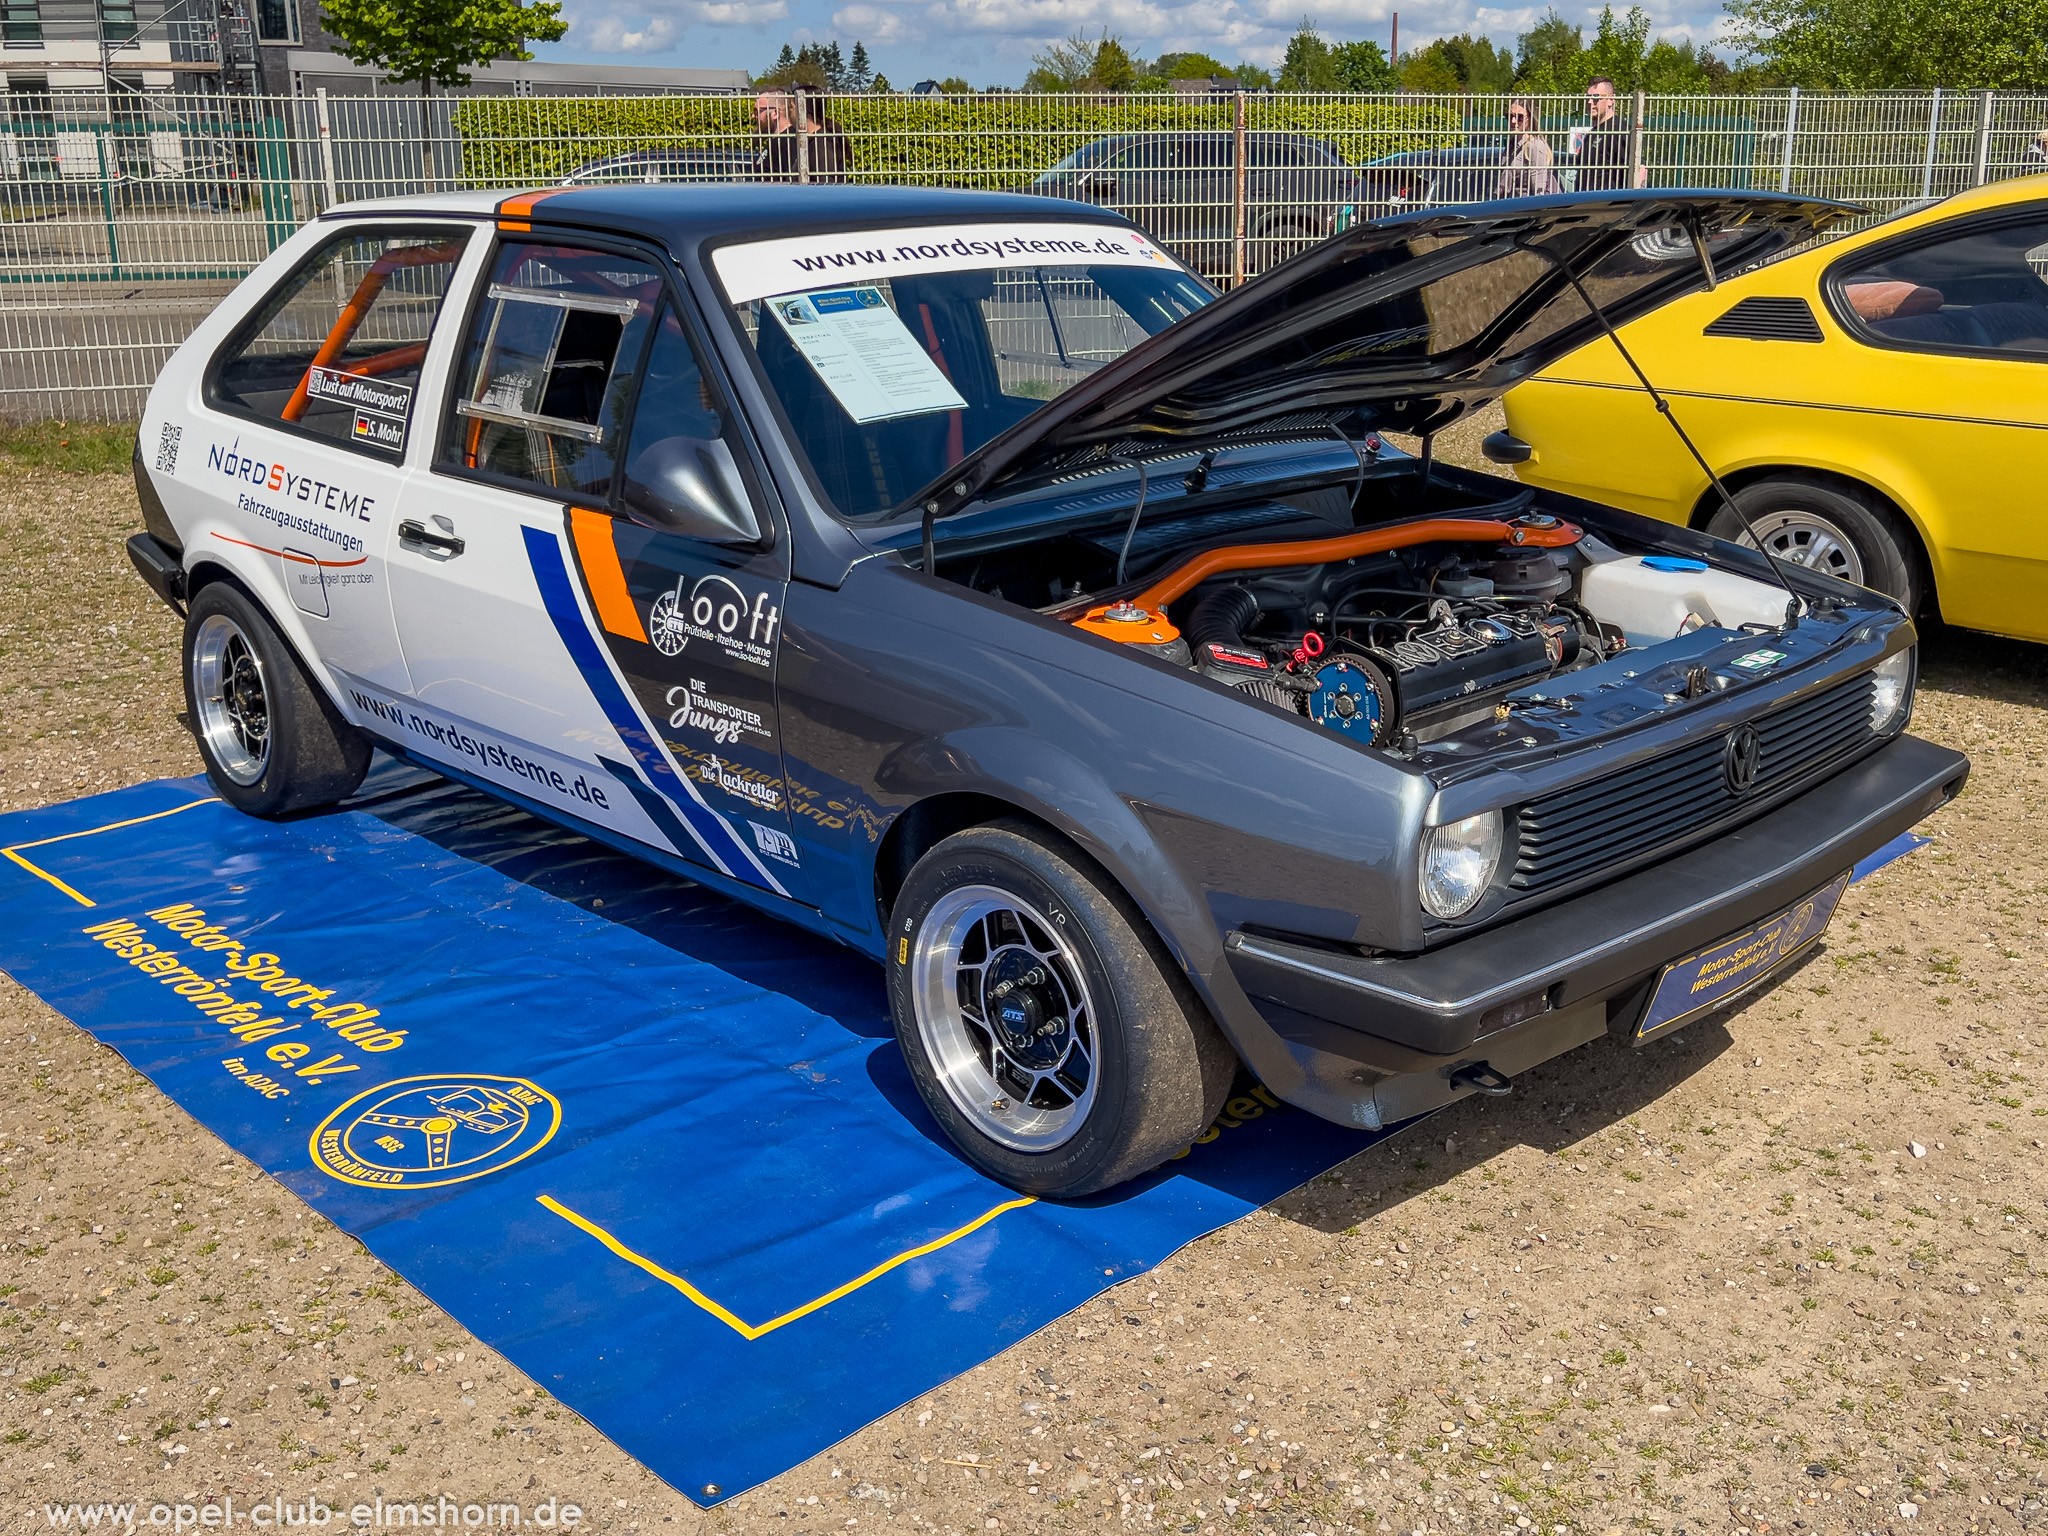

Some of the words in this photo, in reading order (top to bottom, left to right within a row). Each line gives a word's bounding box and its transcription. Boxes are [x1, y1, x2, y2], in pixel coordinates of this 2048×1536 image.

[793, 236, 1130, 273] www.nordsysteme.de
[320, 376, 339, 395] Lust
[339, 380, 354, 399] auf
[354, 383, 408, 412] Motorsport?
[367, 422, 379, 437] S.
[378, 424, 403, 444] Mohr
[238, 493, 363, 553] Fahrzeugausstattungen
[673, 575, 777, 644] Looft
[716, 633, 744, 650] Itzehoe
[746, 642, 771, 658] Marne
[690, 677, 706, 694] DIE
[666, 686, 743, 744] Jungs
[691, 693, 762, 727] TRANSPORTER
[349, 688, 611, 810] www.nordsysteme.de
[700, 764, 716, 781] Die
[716, 760, 779, 803] Lackretter
[145, 903, 410, 1053] Motor-Sport-Club
[82, 918, 302, 1043] Westerrönfeld
[266, 1042, 361, 1086] e.V.
[1002, 1009, 1026, 1021] ATS
[222, 1057, 248, 1080] im
[244, 1072, 291, 1100] ADAC
